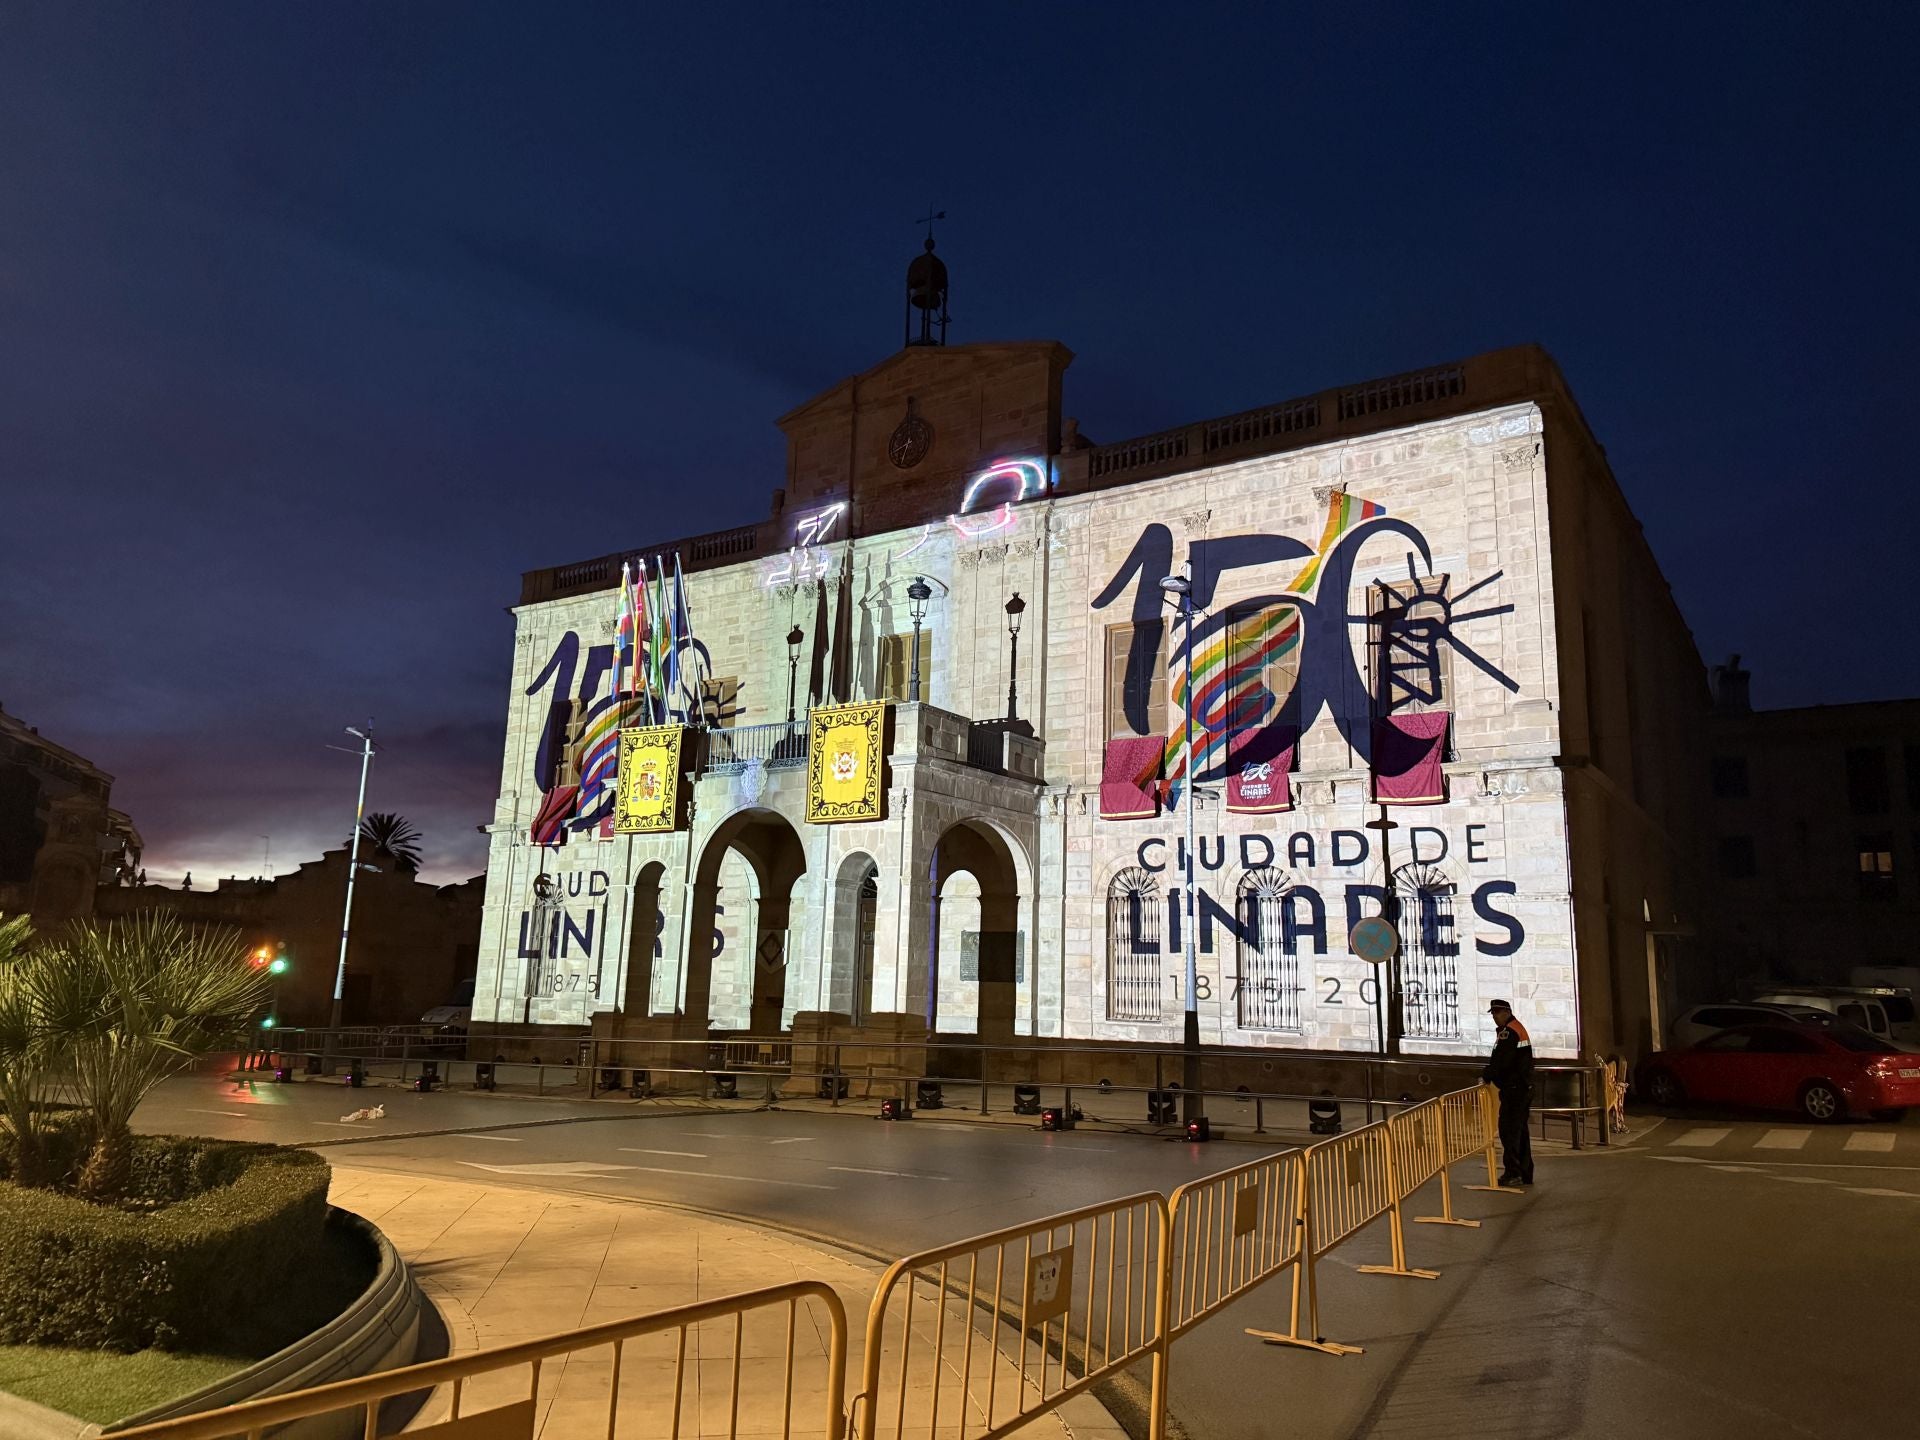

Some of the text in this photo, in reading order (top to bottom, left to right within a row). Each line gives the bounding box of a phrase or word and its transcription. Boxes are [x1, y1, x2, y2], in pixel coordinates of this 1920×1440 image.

[1091, 516, 1443, 784] 150
[1137, 824, 1489, 872] CIUDAD DE
